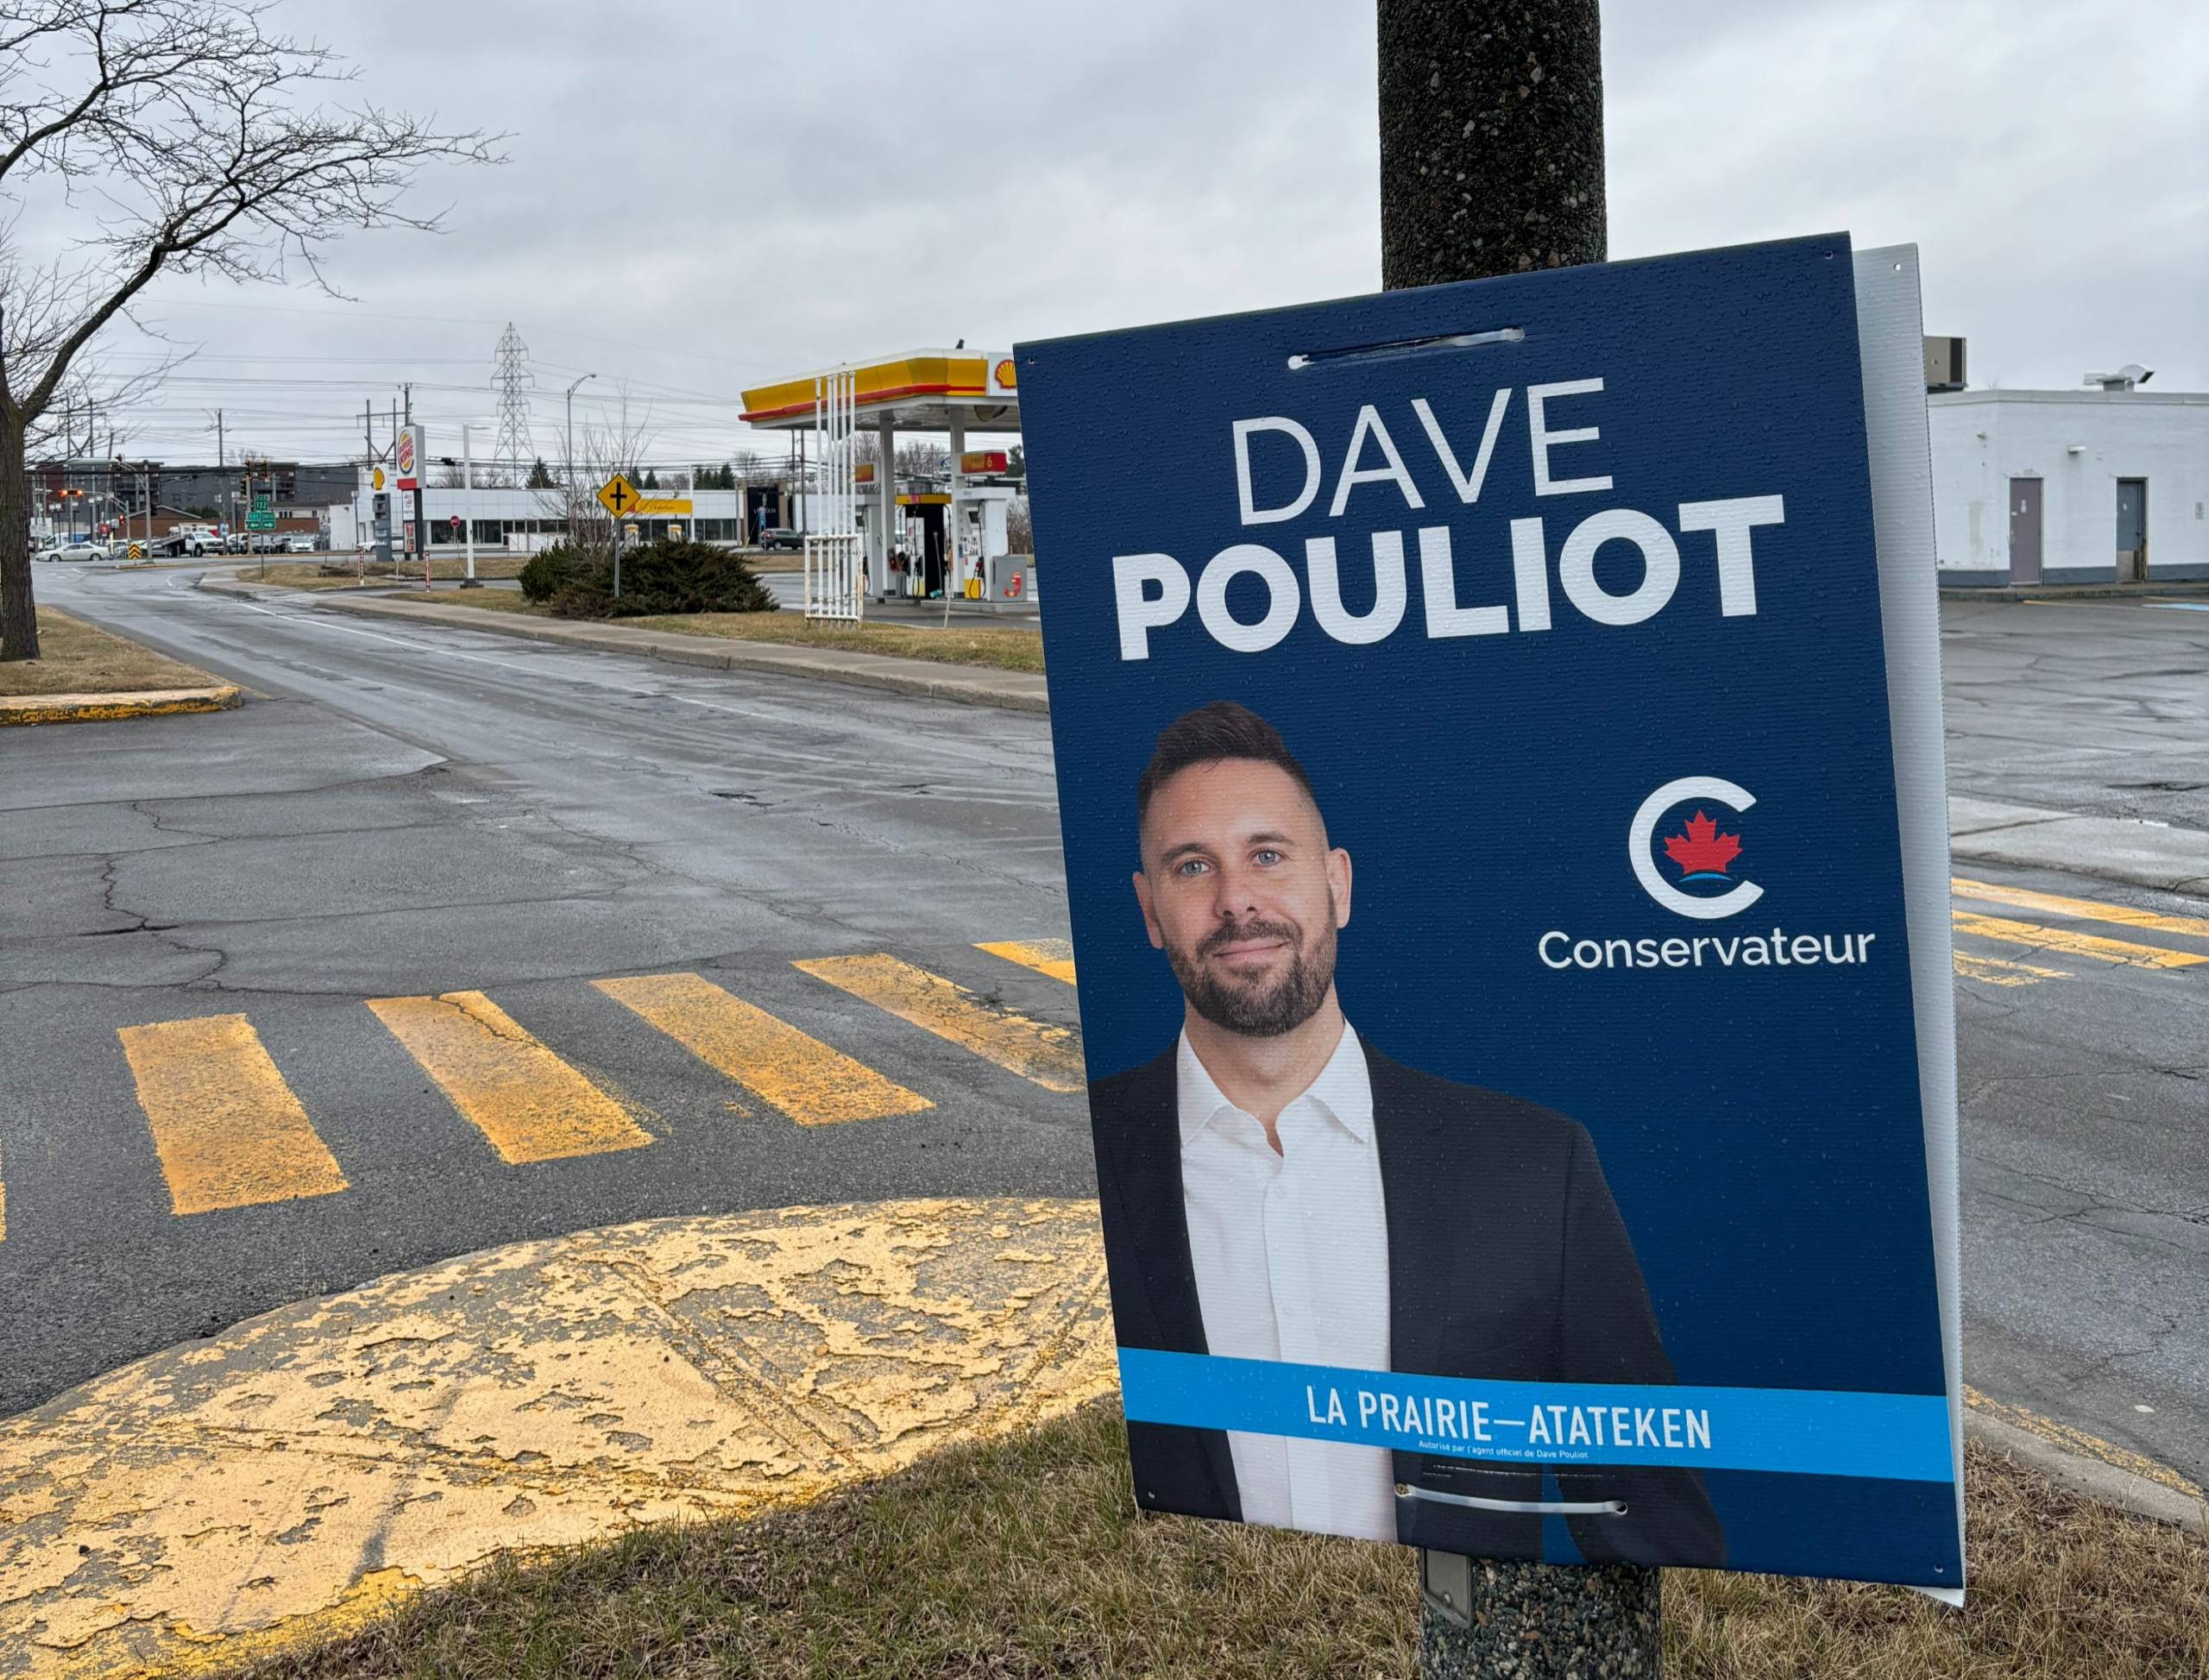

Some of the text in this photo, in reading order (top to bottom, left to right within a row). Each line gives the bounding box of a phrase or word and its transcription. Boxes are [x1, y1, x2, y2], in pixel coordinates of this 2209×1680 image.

[986, 456, 993, 469] 6
[1233, 378, 1614, 525] DAVE
[1112, 494, 1785, 661] POULIOT
[1539, 928, 1876, 969] Conservateur
[1306, 1385, 1347, 1426] LA
[1418, 1439, 1589, 1459] Autorisé par l'agent officiel de Dave Pouliot
